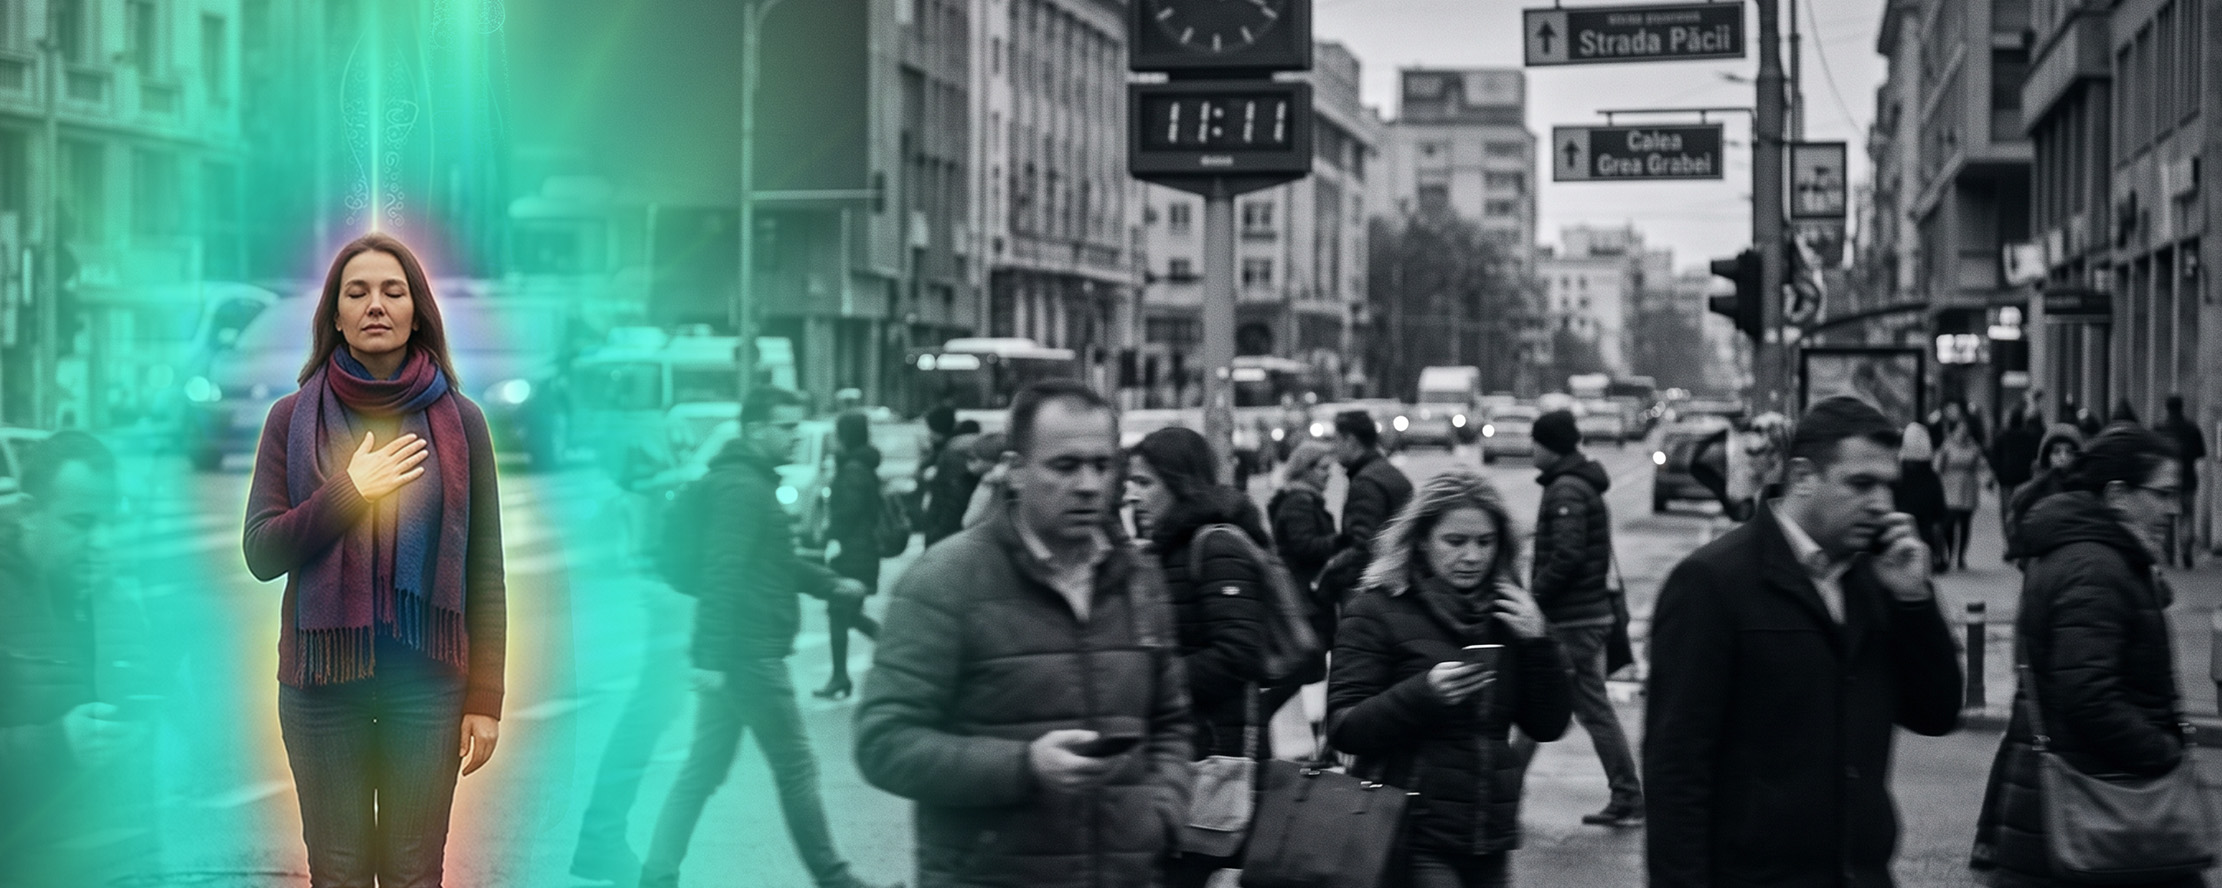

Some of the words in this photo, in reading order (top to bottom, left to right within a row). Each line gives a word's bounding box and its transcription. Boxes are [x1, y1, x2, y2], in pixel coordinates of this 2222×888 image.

[1579, 28, 1661, 56] Strada
[1168, 101, 1287, 143] 11:11
[1627, 129, 1683, 151] Calea
[1598, 153, 1642, 175] Grea
